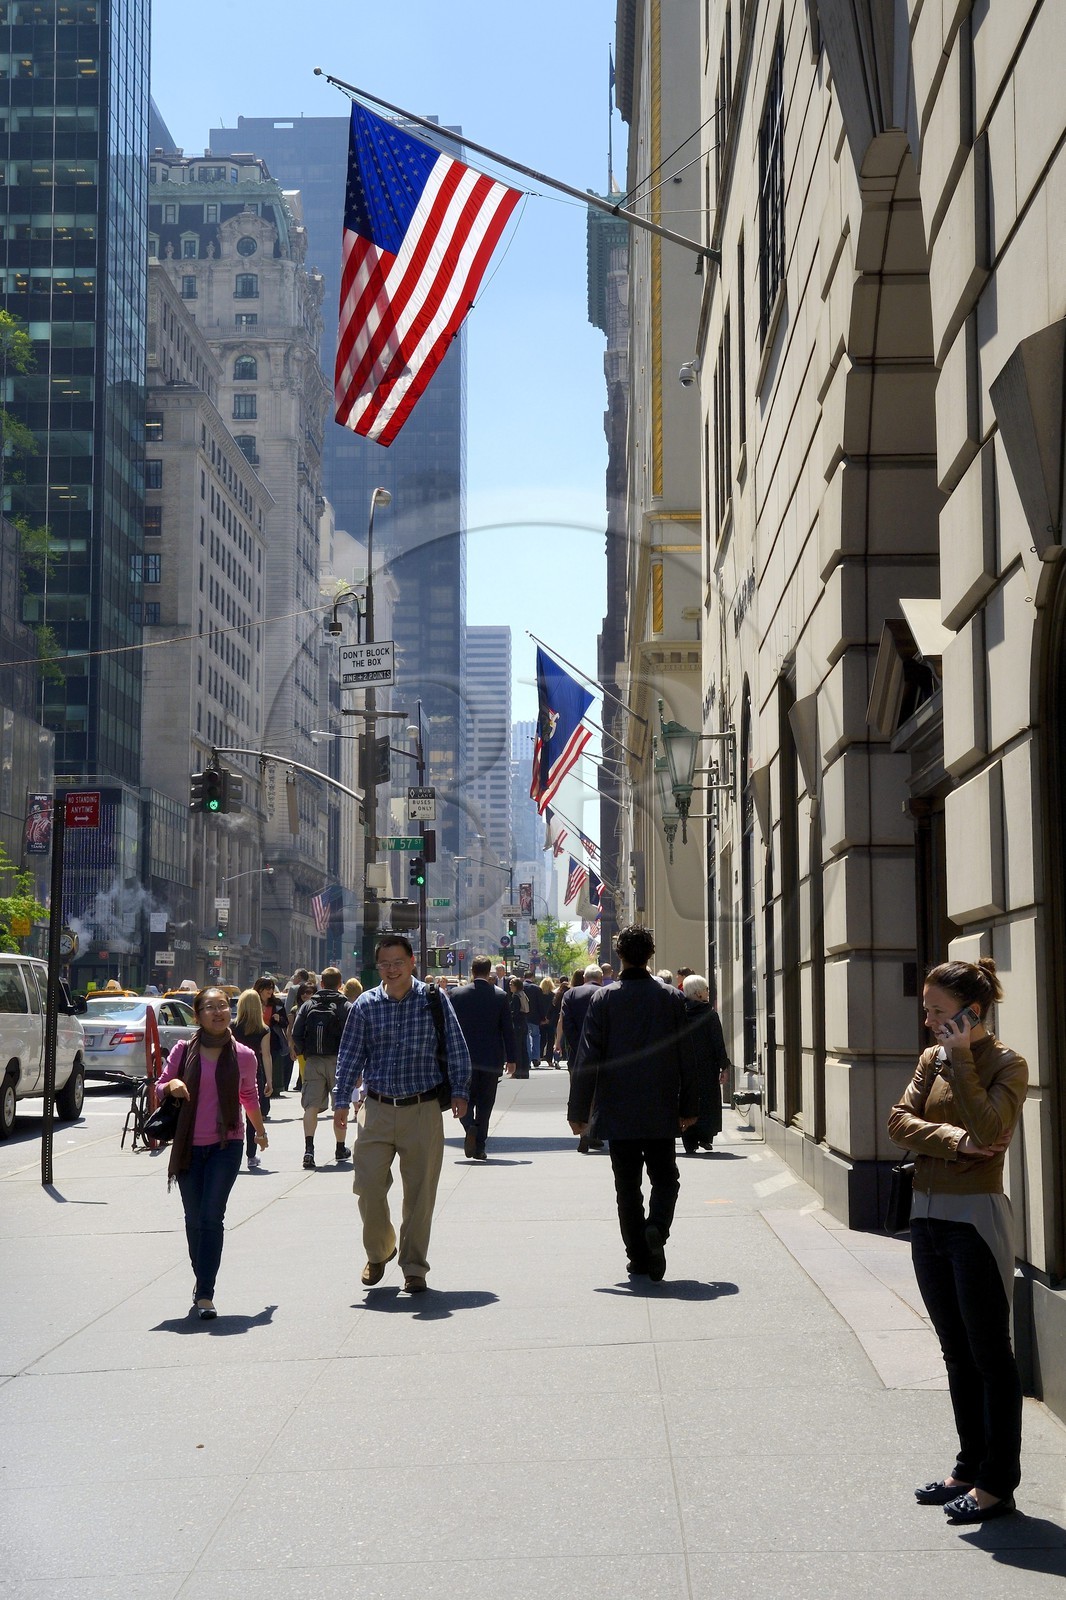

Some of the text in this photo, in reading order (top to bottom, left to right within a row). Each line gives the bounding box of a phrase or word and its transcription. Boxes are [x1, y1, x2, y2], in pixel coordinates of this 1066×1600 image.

[343, 648, 390, 659] DON'T BLOCK
[352, 658, 382, 668] THE BOX
[343, 674, 357, 682] FINE
[75, 795, 97, 803] STANDING
[400, 838, 412, 849] 57
